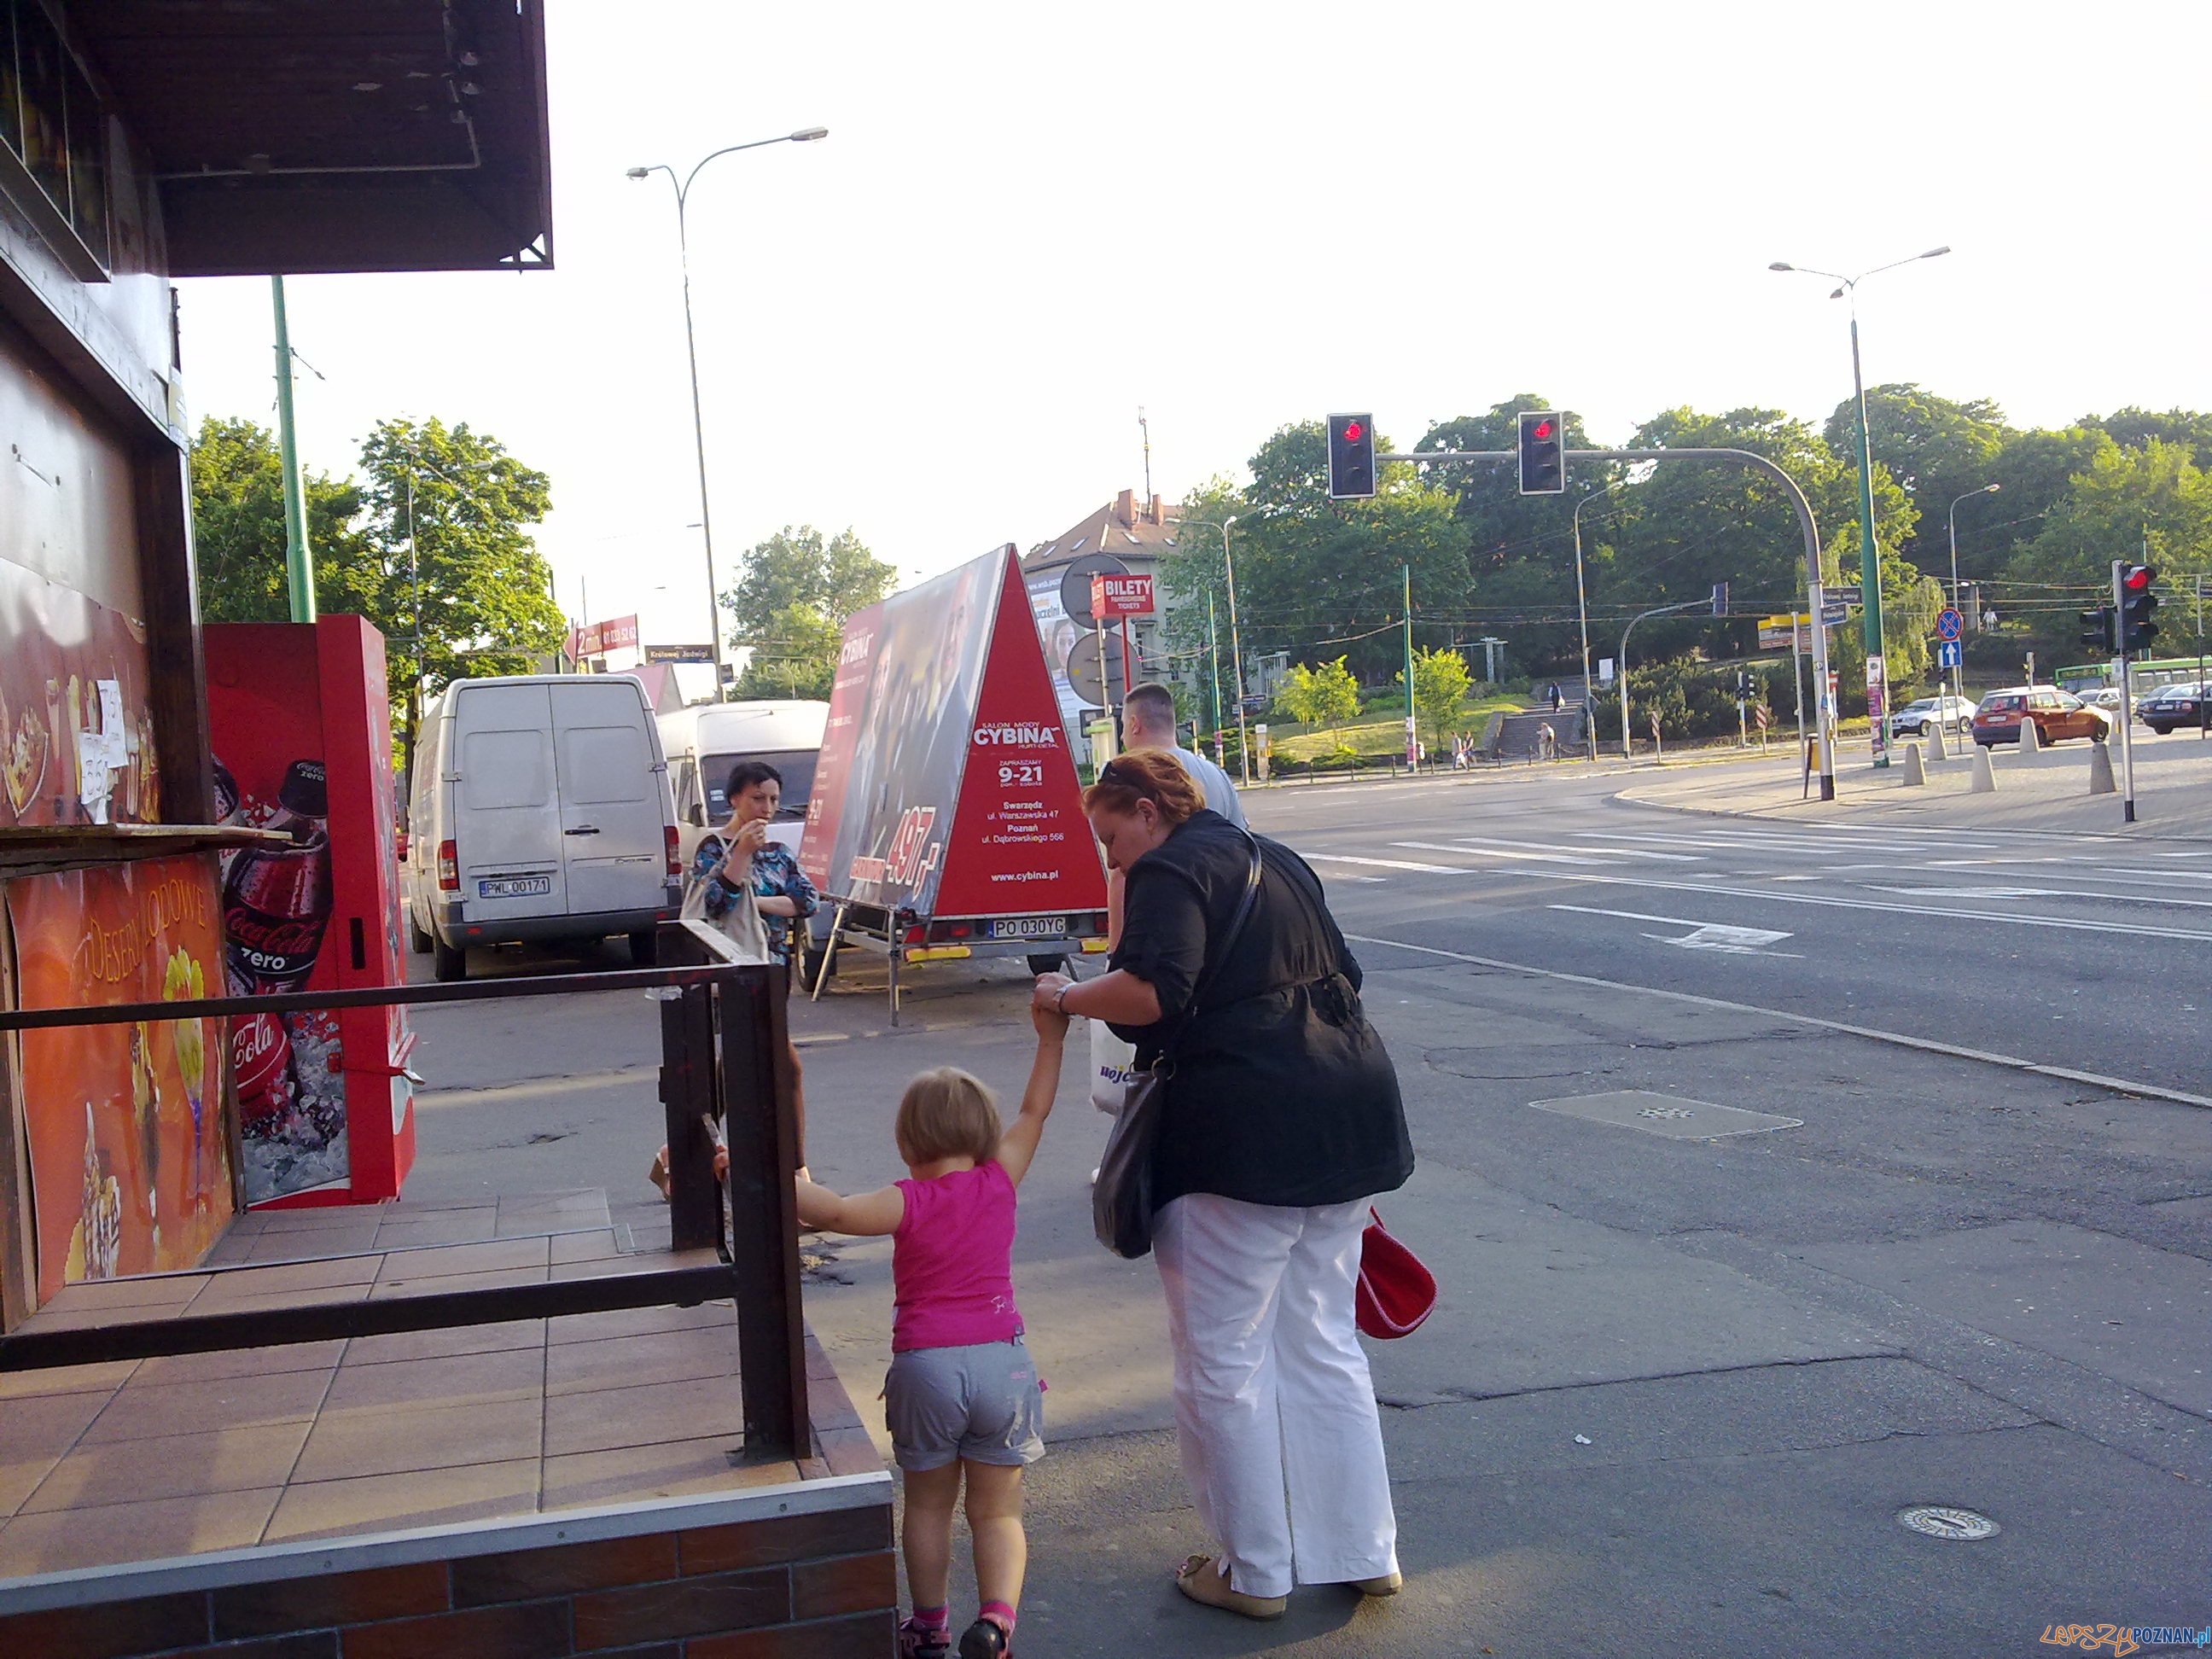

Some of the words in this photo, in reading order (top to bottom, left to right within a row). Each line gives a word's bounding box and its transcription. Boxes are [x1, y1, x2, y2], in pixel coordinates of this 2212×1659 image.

[1104, 579, 1152, 596] BILETY
[578, 631, 585, 654] 2
[585, 633, 602, 651] min.
[974, 727, 1060, 745] CYBINA
[300, 771, 324, 782] zero
[998, 765, 1043, 783] 9-21
[1003, 800, 1043, 811] Swarzędz
[998, 810, 1047, 819] Warszawska
[1049, 810, 1059, 818] 47
[1007, 824, 1039, 832] Poznań
[991, 870, 1058, 882] www.cybina.pl
[486, 883, 509, 894] PWL
[512, 880, 546, 893] 00171
[146, 879, 206, 946] ODOWE
[996, 923, 1016, 935] PO
[1022, 919, 1064, 934] 030YG
[241, 947, 286, 970] zero
